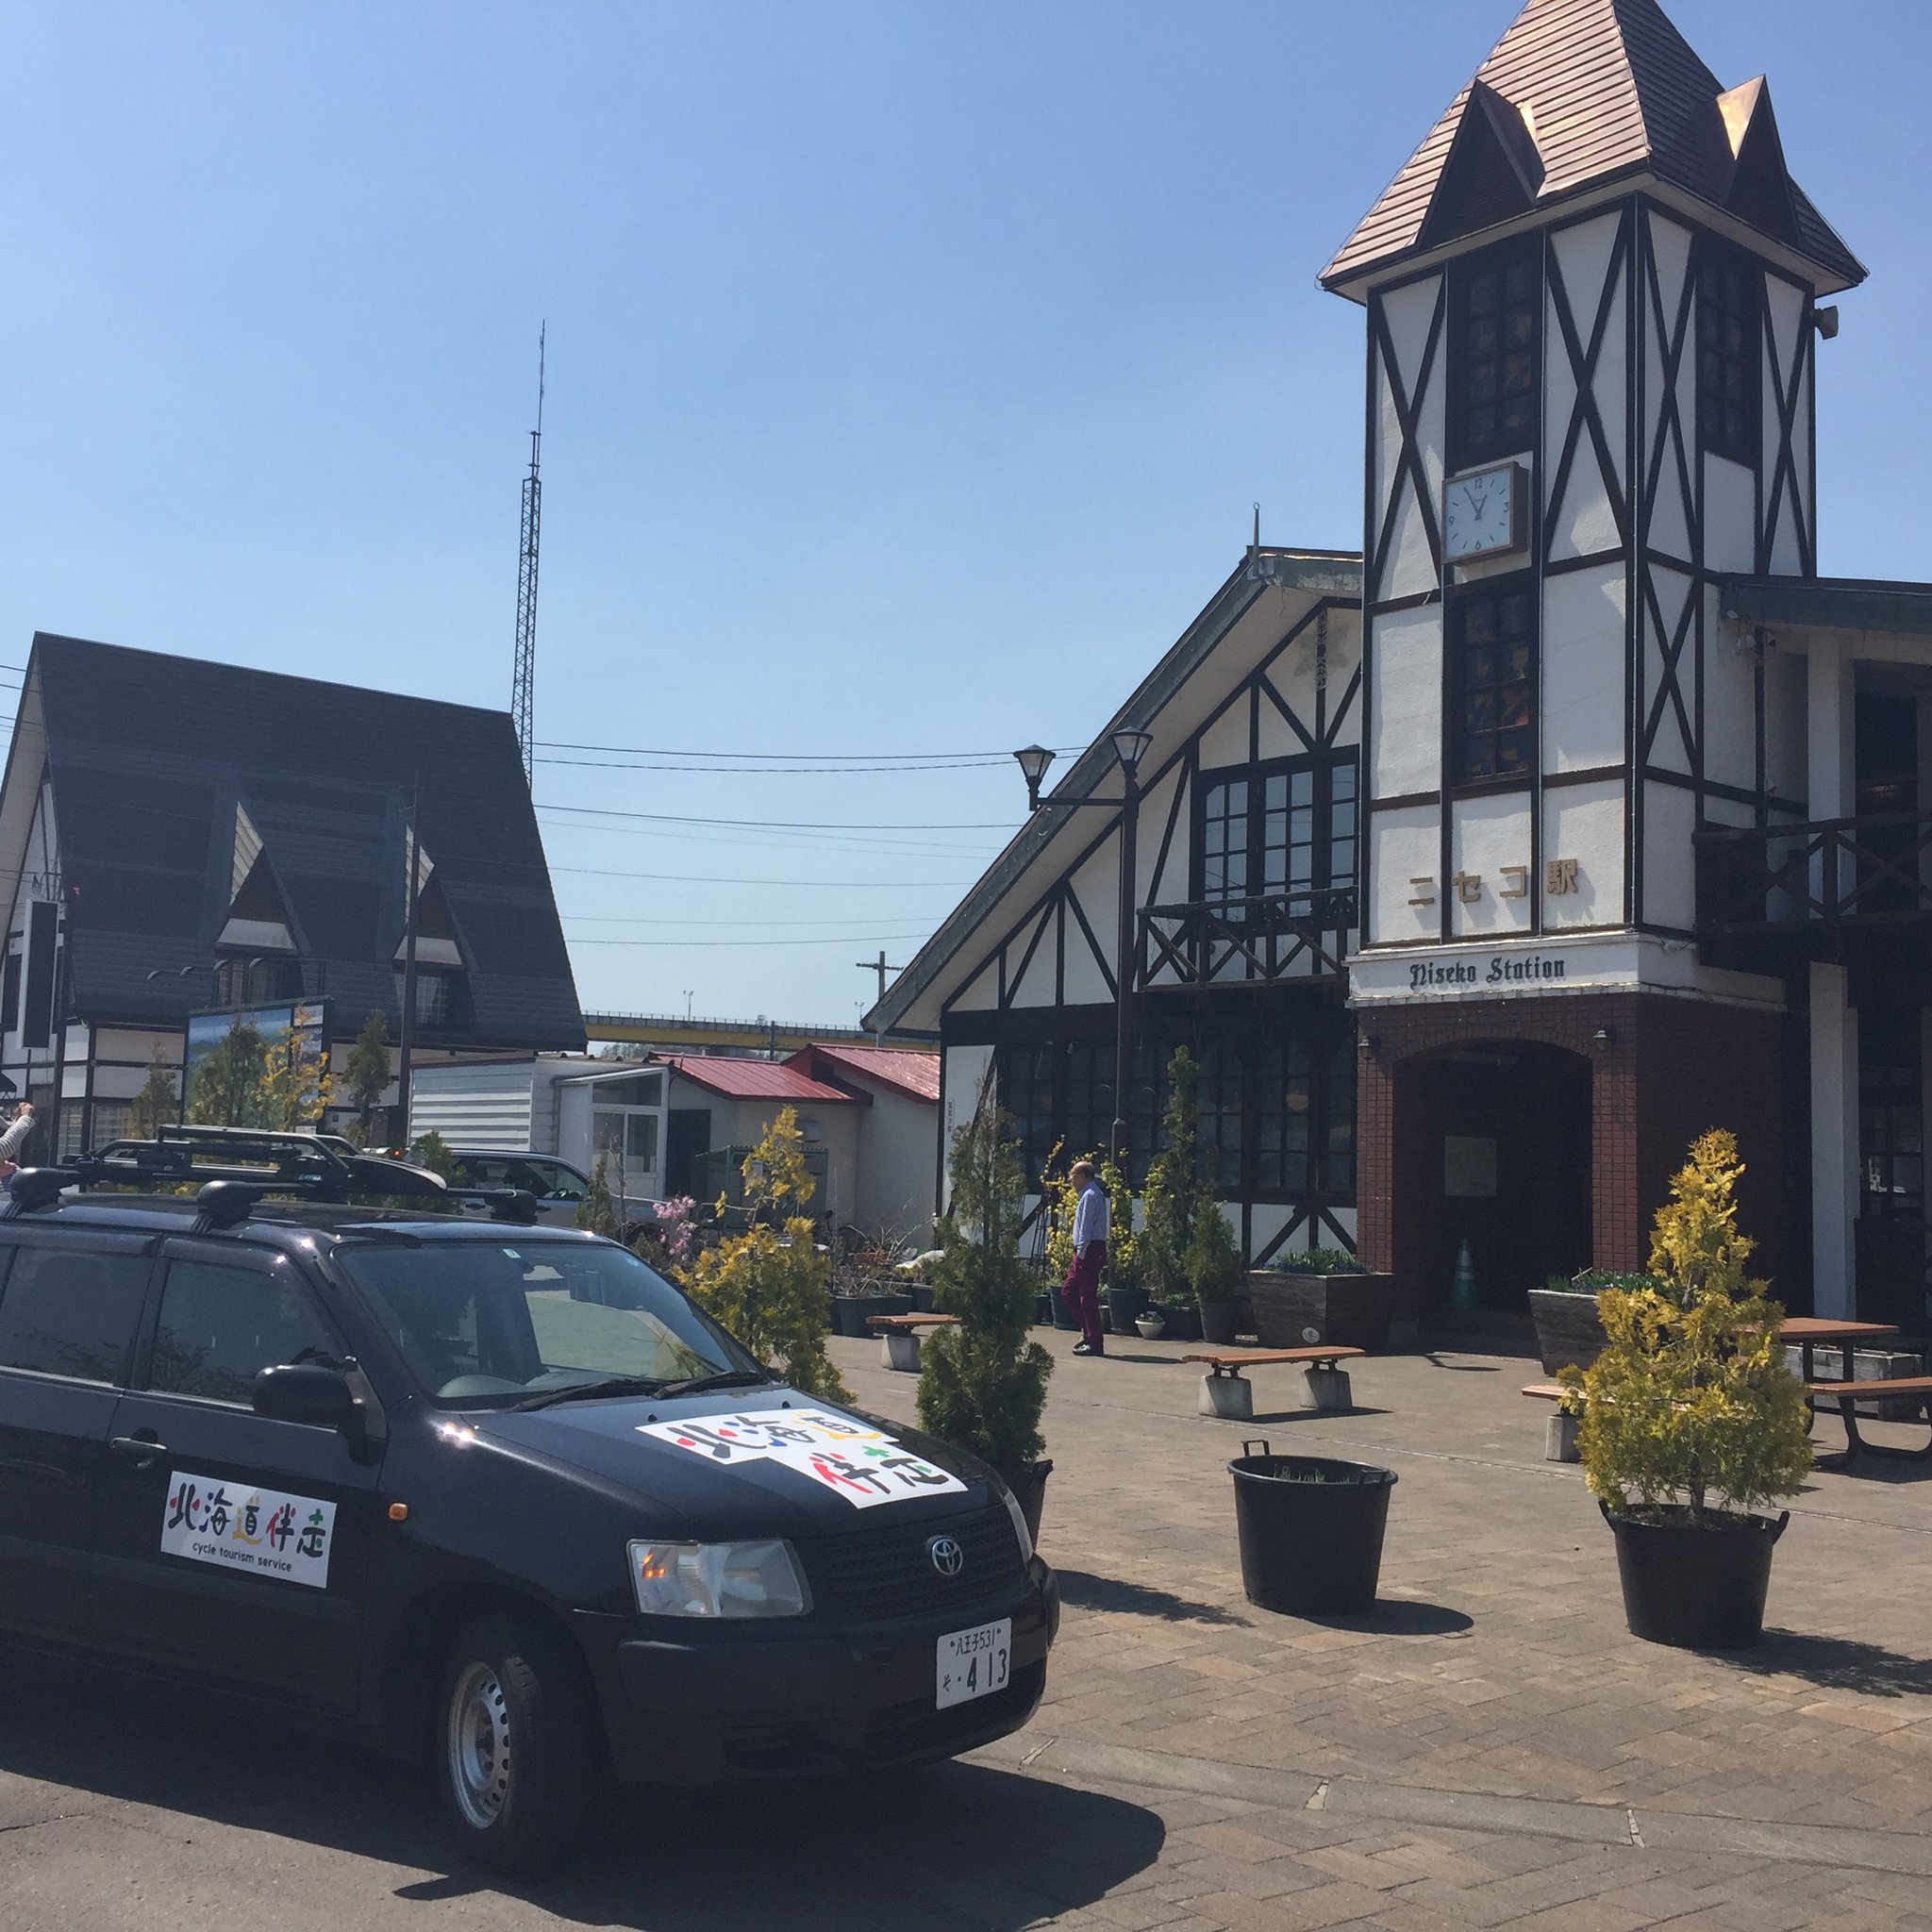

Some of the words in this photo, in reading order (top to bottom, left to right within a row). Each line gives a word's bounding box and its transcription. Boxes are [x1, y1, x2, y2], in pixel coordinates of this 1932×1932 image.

[1474, 477, 1483, 490] 12
[1503, 502, 1509, 513] 3
[1448, 515, 1455, 526] 9
[1474, 540, 1482, 550] 6
[1407, 858, 1578, 907] ニセコ駅
[1409, 960, 1477, 991] Niseko
[1486, 955, 1565, 984] Station
[192, 1541, 216, 1557] cycle
[219, 1544, 255, 1564] tourism
[258, 1555, 292, 1573] service
